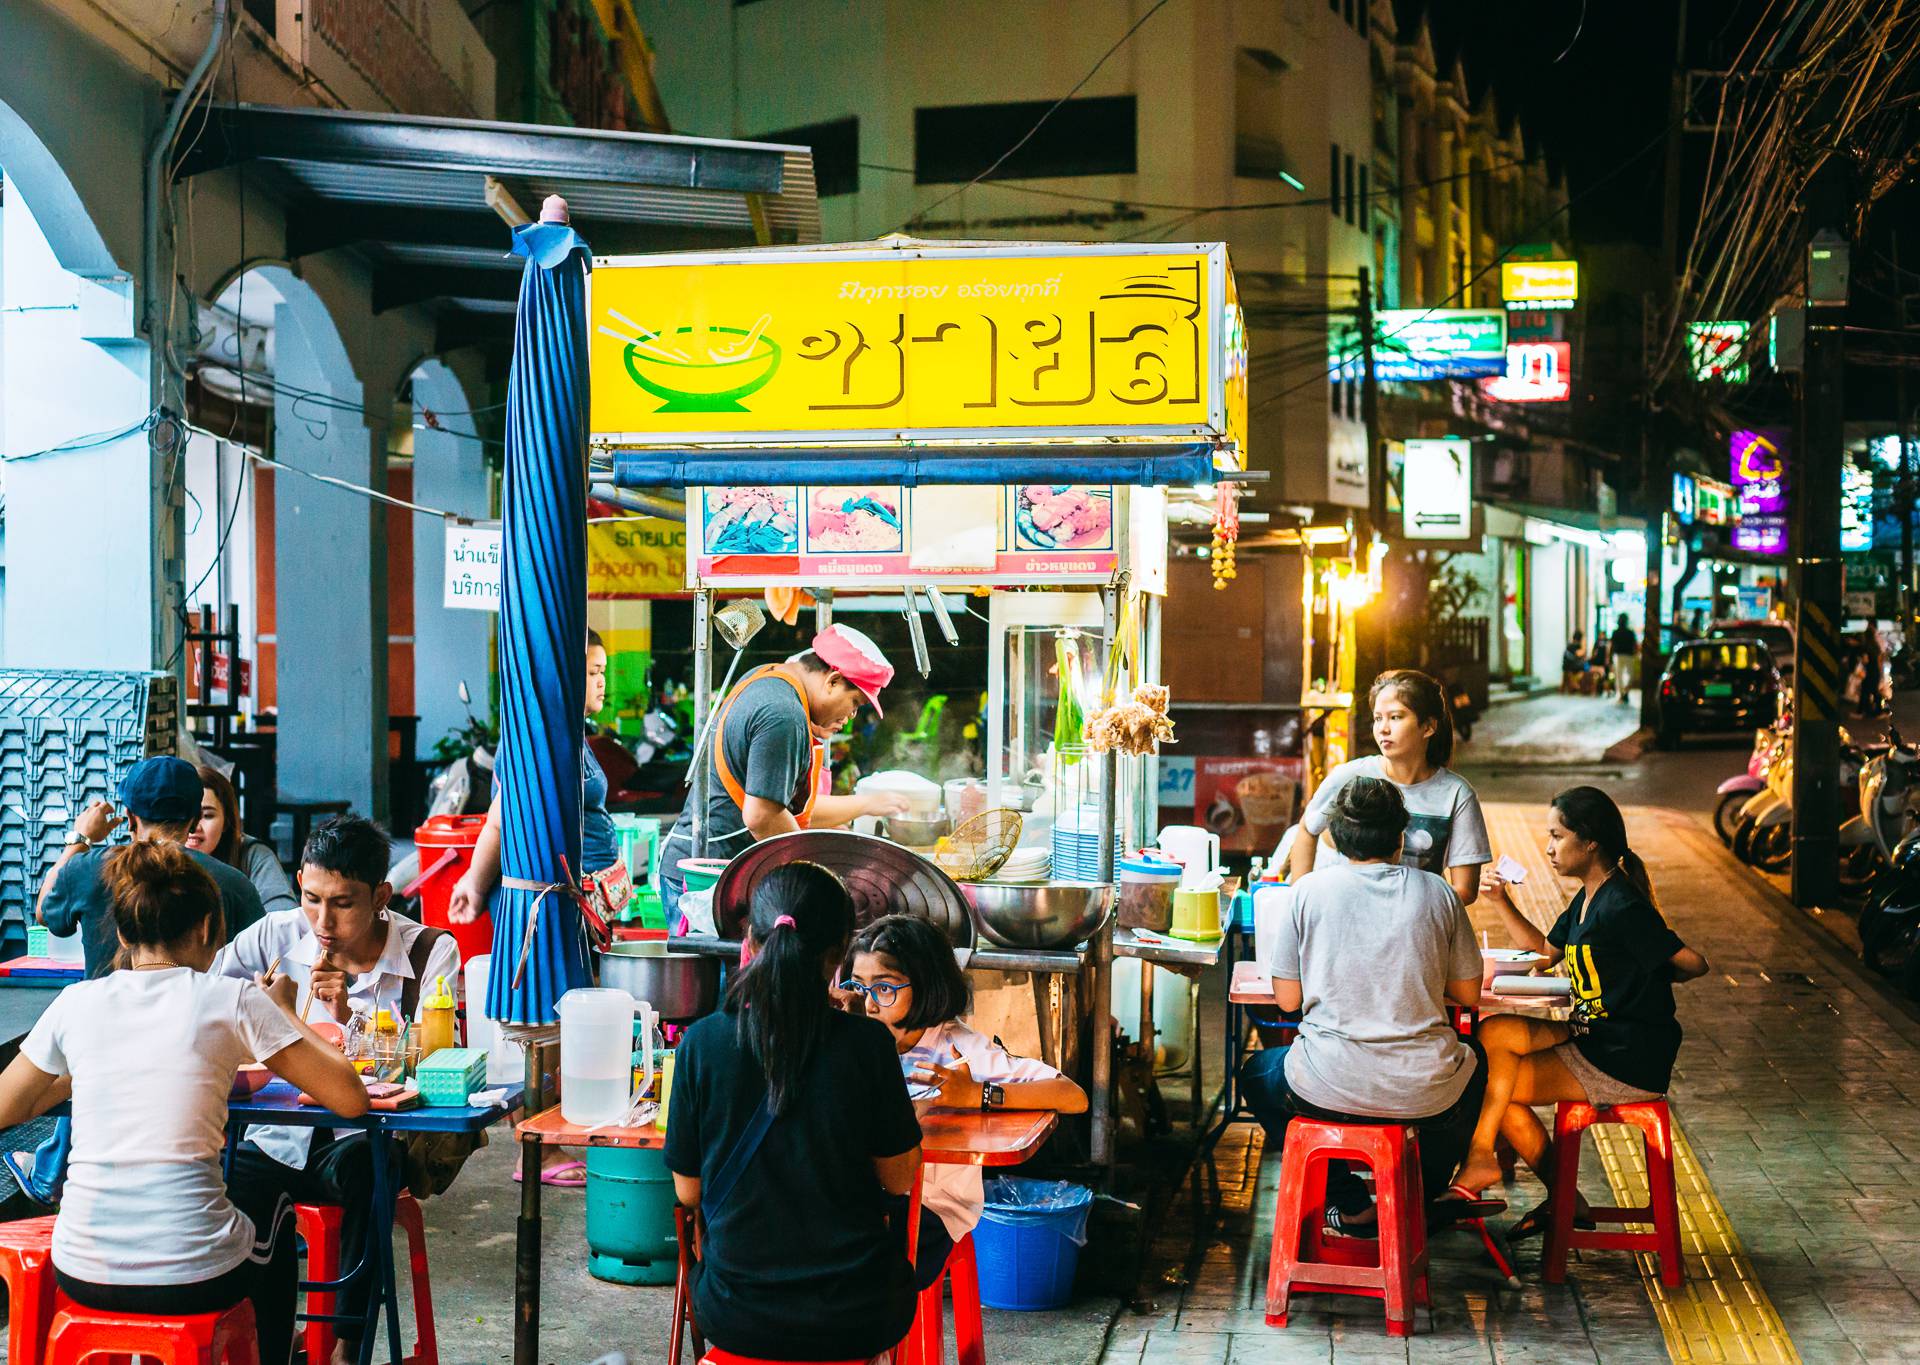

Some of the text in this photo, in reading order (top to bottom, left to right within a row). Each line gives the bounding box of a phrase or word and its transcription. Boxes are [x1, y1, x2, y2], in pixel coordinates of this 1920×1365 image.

[838, 281, 949, 304] มีทุกซอย
[796, 261, 1201, 411] ชายสี่
[453, 537, 500, 564] น้ำแข็
